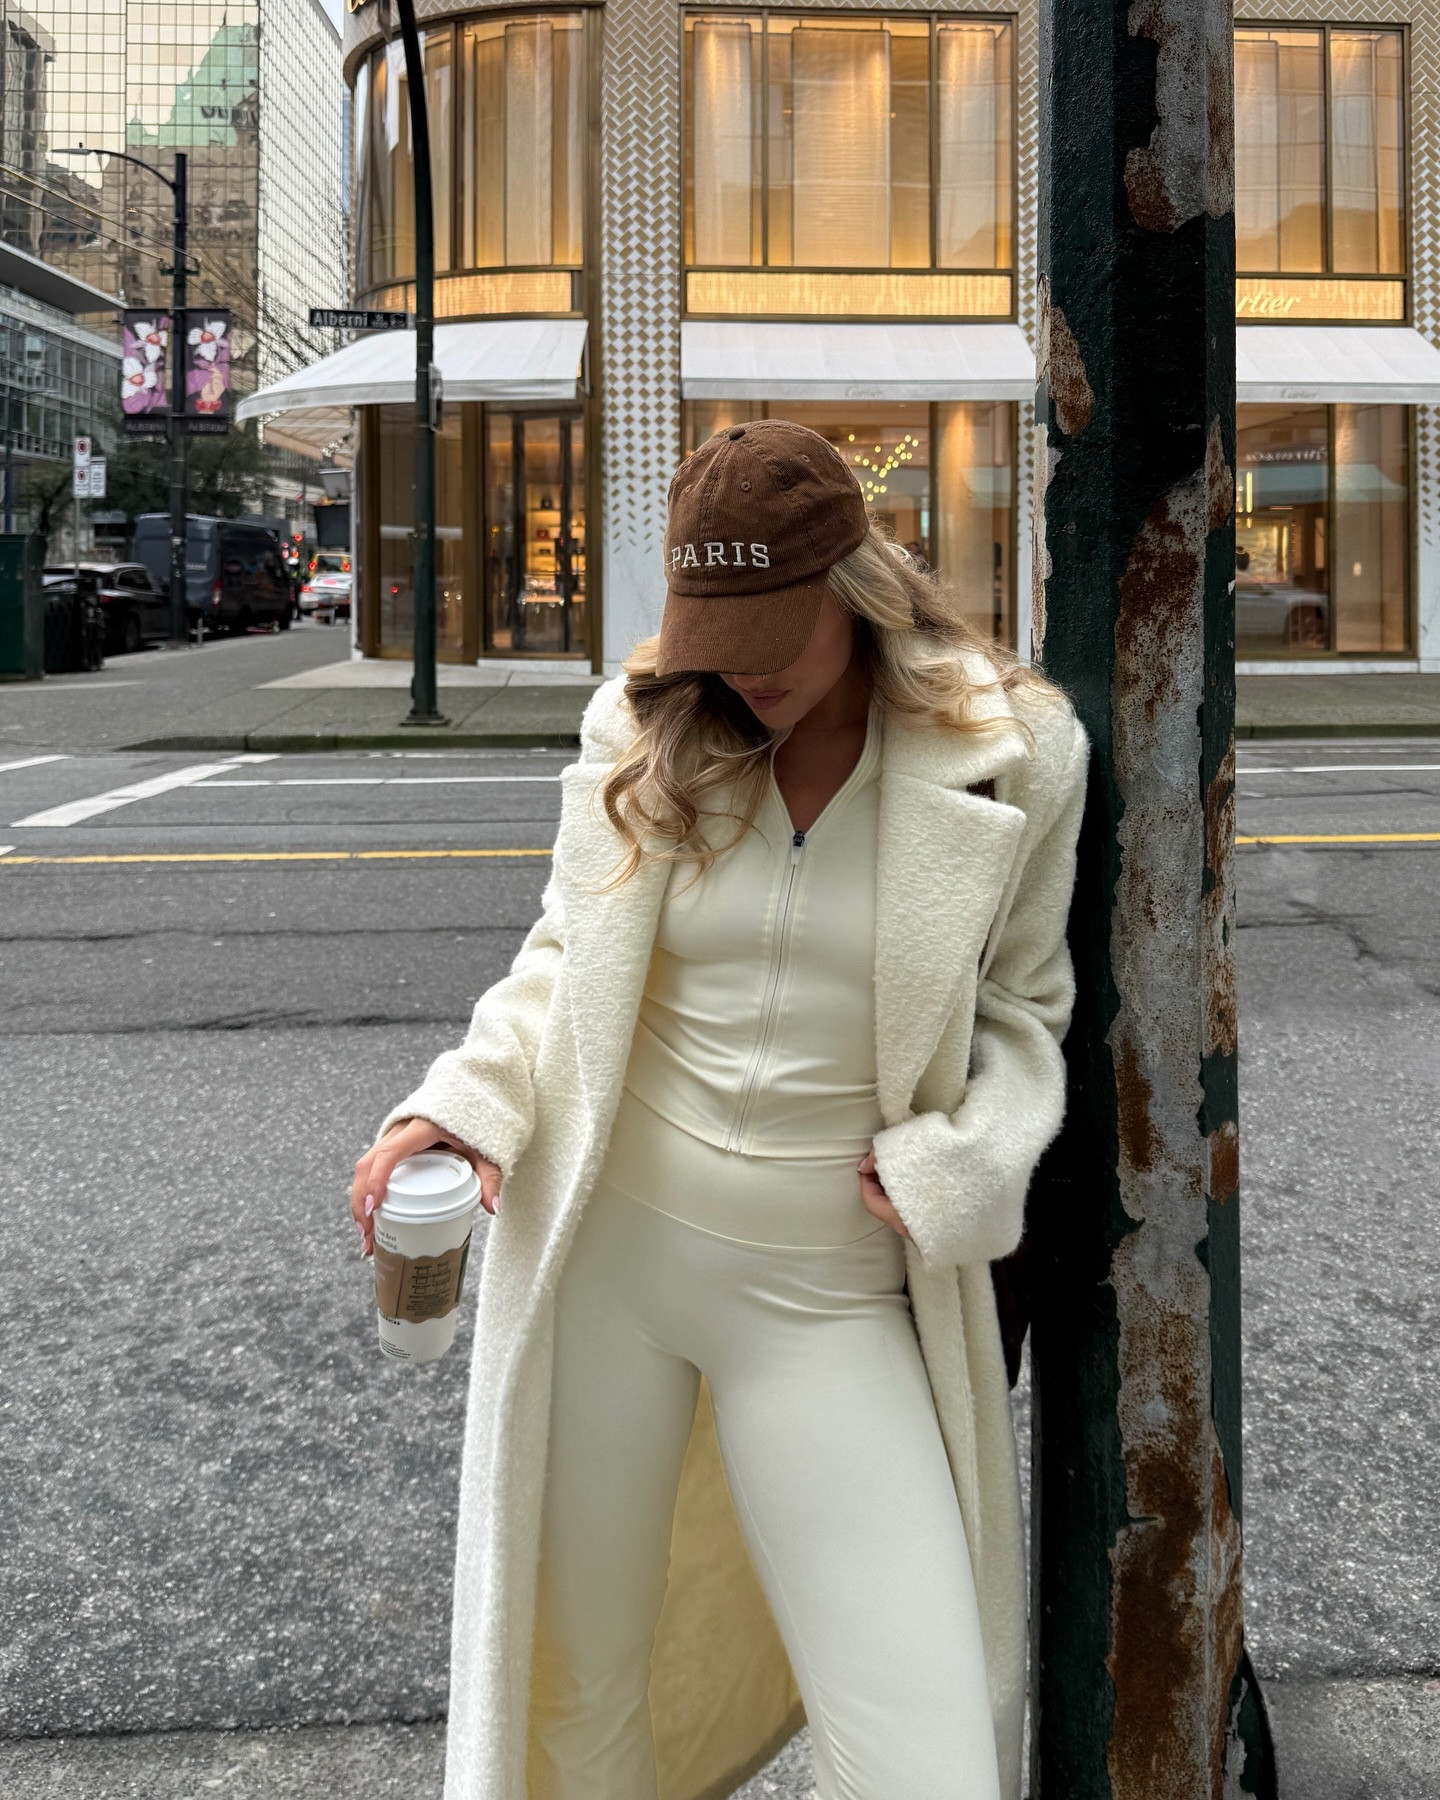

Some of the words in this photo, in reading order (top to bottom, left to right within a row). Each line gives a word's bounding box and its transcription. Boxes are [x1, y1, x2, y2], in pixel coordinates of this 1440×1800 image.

[1236, 288, 1301, 314] rtier
[314, 311, 368, 328] Alberni
[669, 542, 770, 572] PARIS
